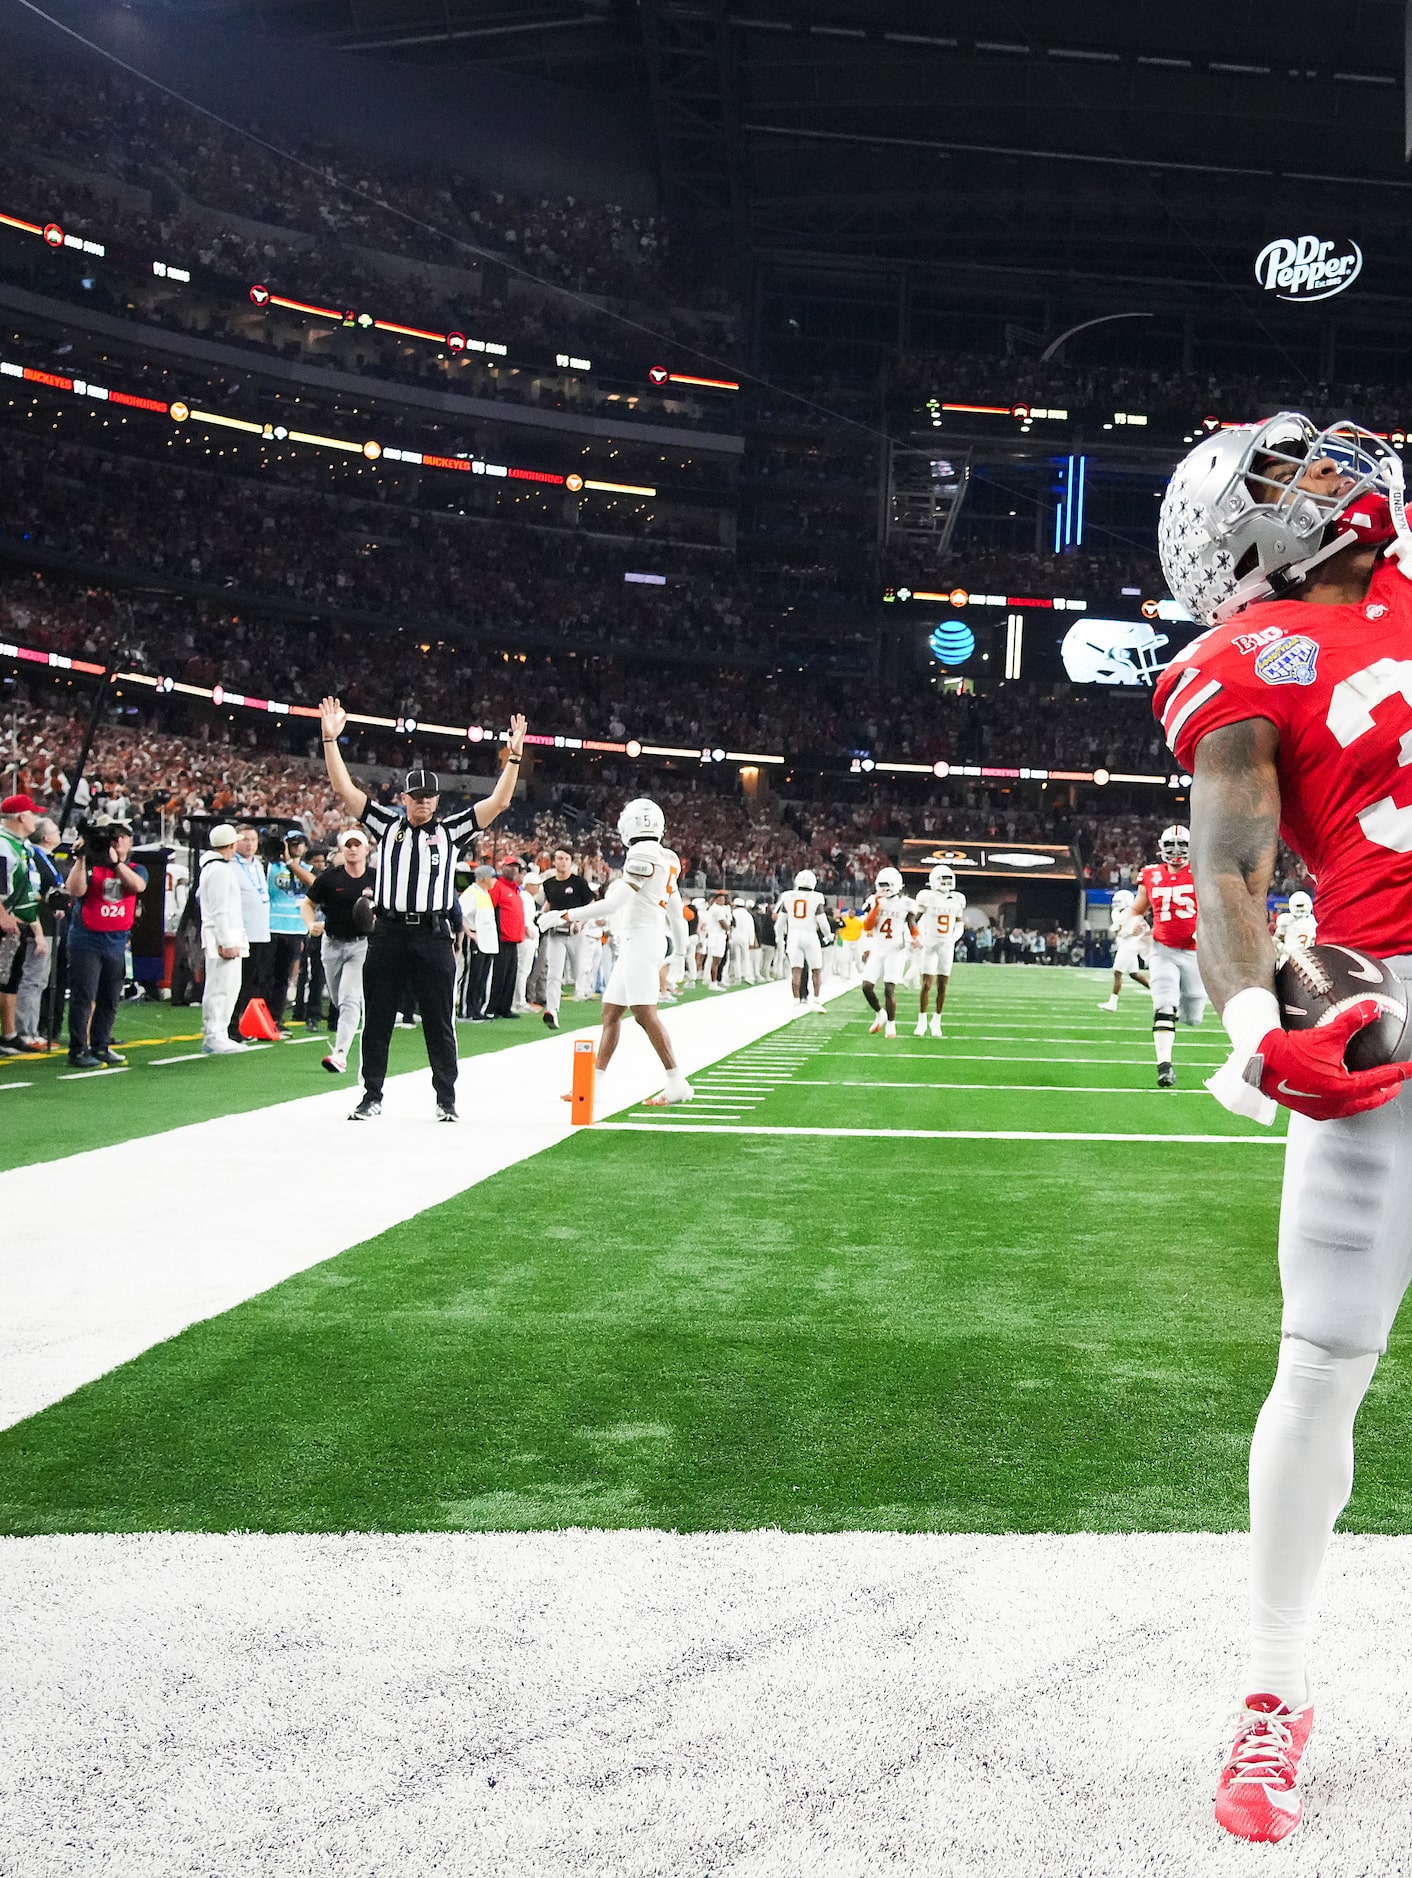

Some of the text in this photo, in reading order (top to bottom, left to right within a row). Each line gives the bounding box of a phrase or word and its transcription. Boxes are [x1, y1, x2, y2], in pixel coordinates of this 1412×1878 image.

[1294, 235, 1335, 266] Dr
[1255, 238, 1356, 293] Pepper
[23, 367, 73, 391] BUCKEYES
[422, 454, 471, 471] BUCKEYES
[508, 468, 564, 484] LONGHORNS
[431, 854, 440, 866] S
[100, 905, 126, 918] 024
[794, 899, 807, 919] 0
[1152, 884, 1198, 921] 75
[880, 918, 893, 939] 4
[937, 915, 949, 934] 9
